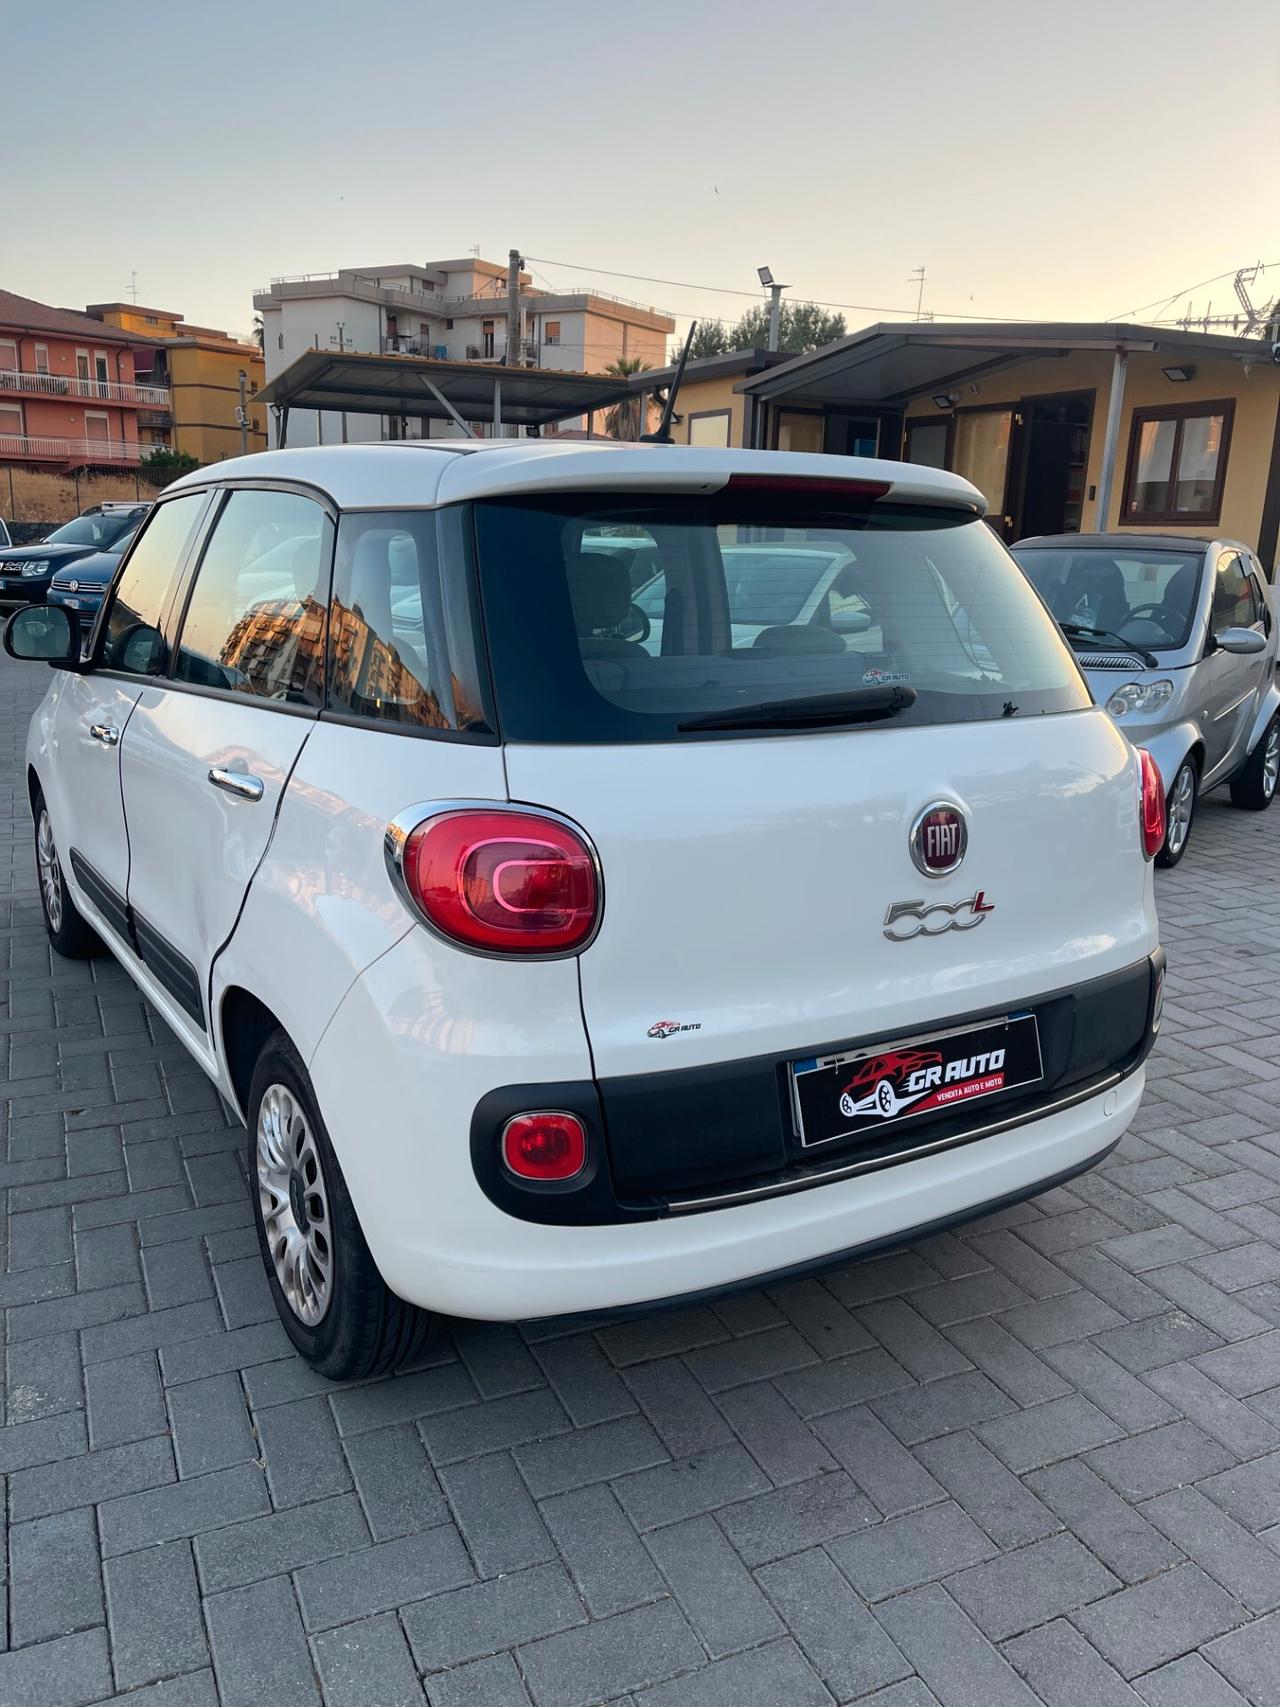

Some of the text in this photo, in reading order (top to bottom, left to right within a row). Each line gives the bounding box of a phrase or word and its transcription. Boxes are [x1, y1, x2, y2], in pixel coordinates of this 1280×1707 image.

[927, 823, 958, 858] FIAT
[681, 1023, 701, 1031] AUTO
[907, 1065, 942, 1092] GR
[944, 1049, 1006, 1082] AUTO
[936, 1077, 1003, 1101] VENDITA AUTO E MOTO
